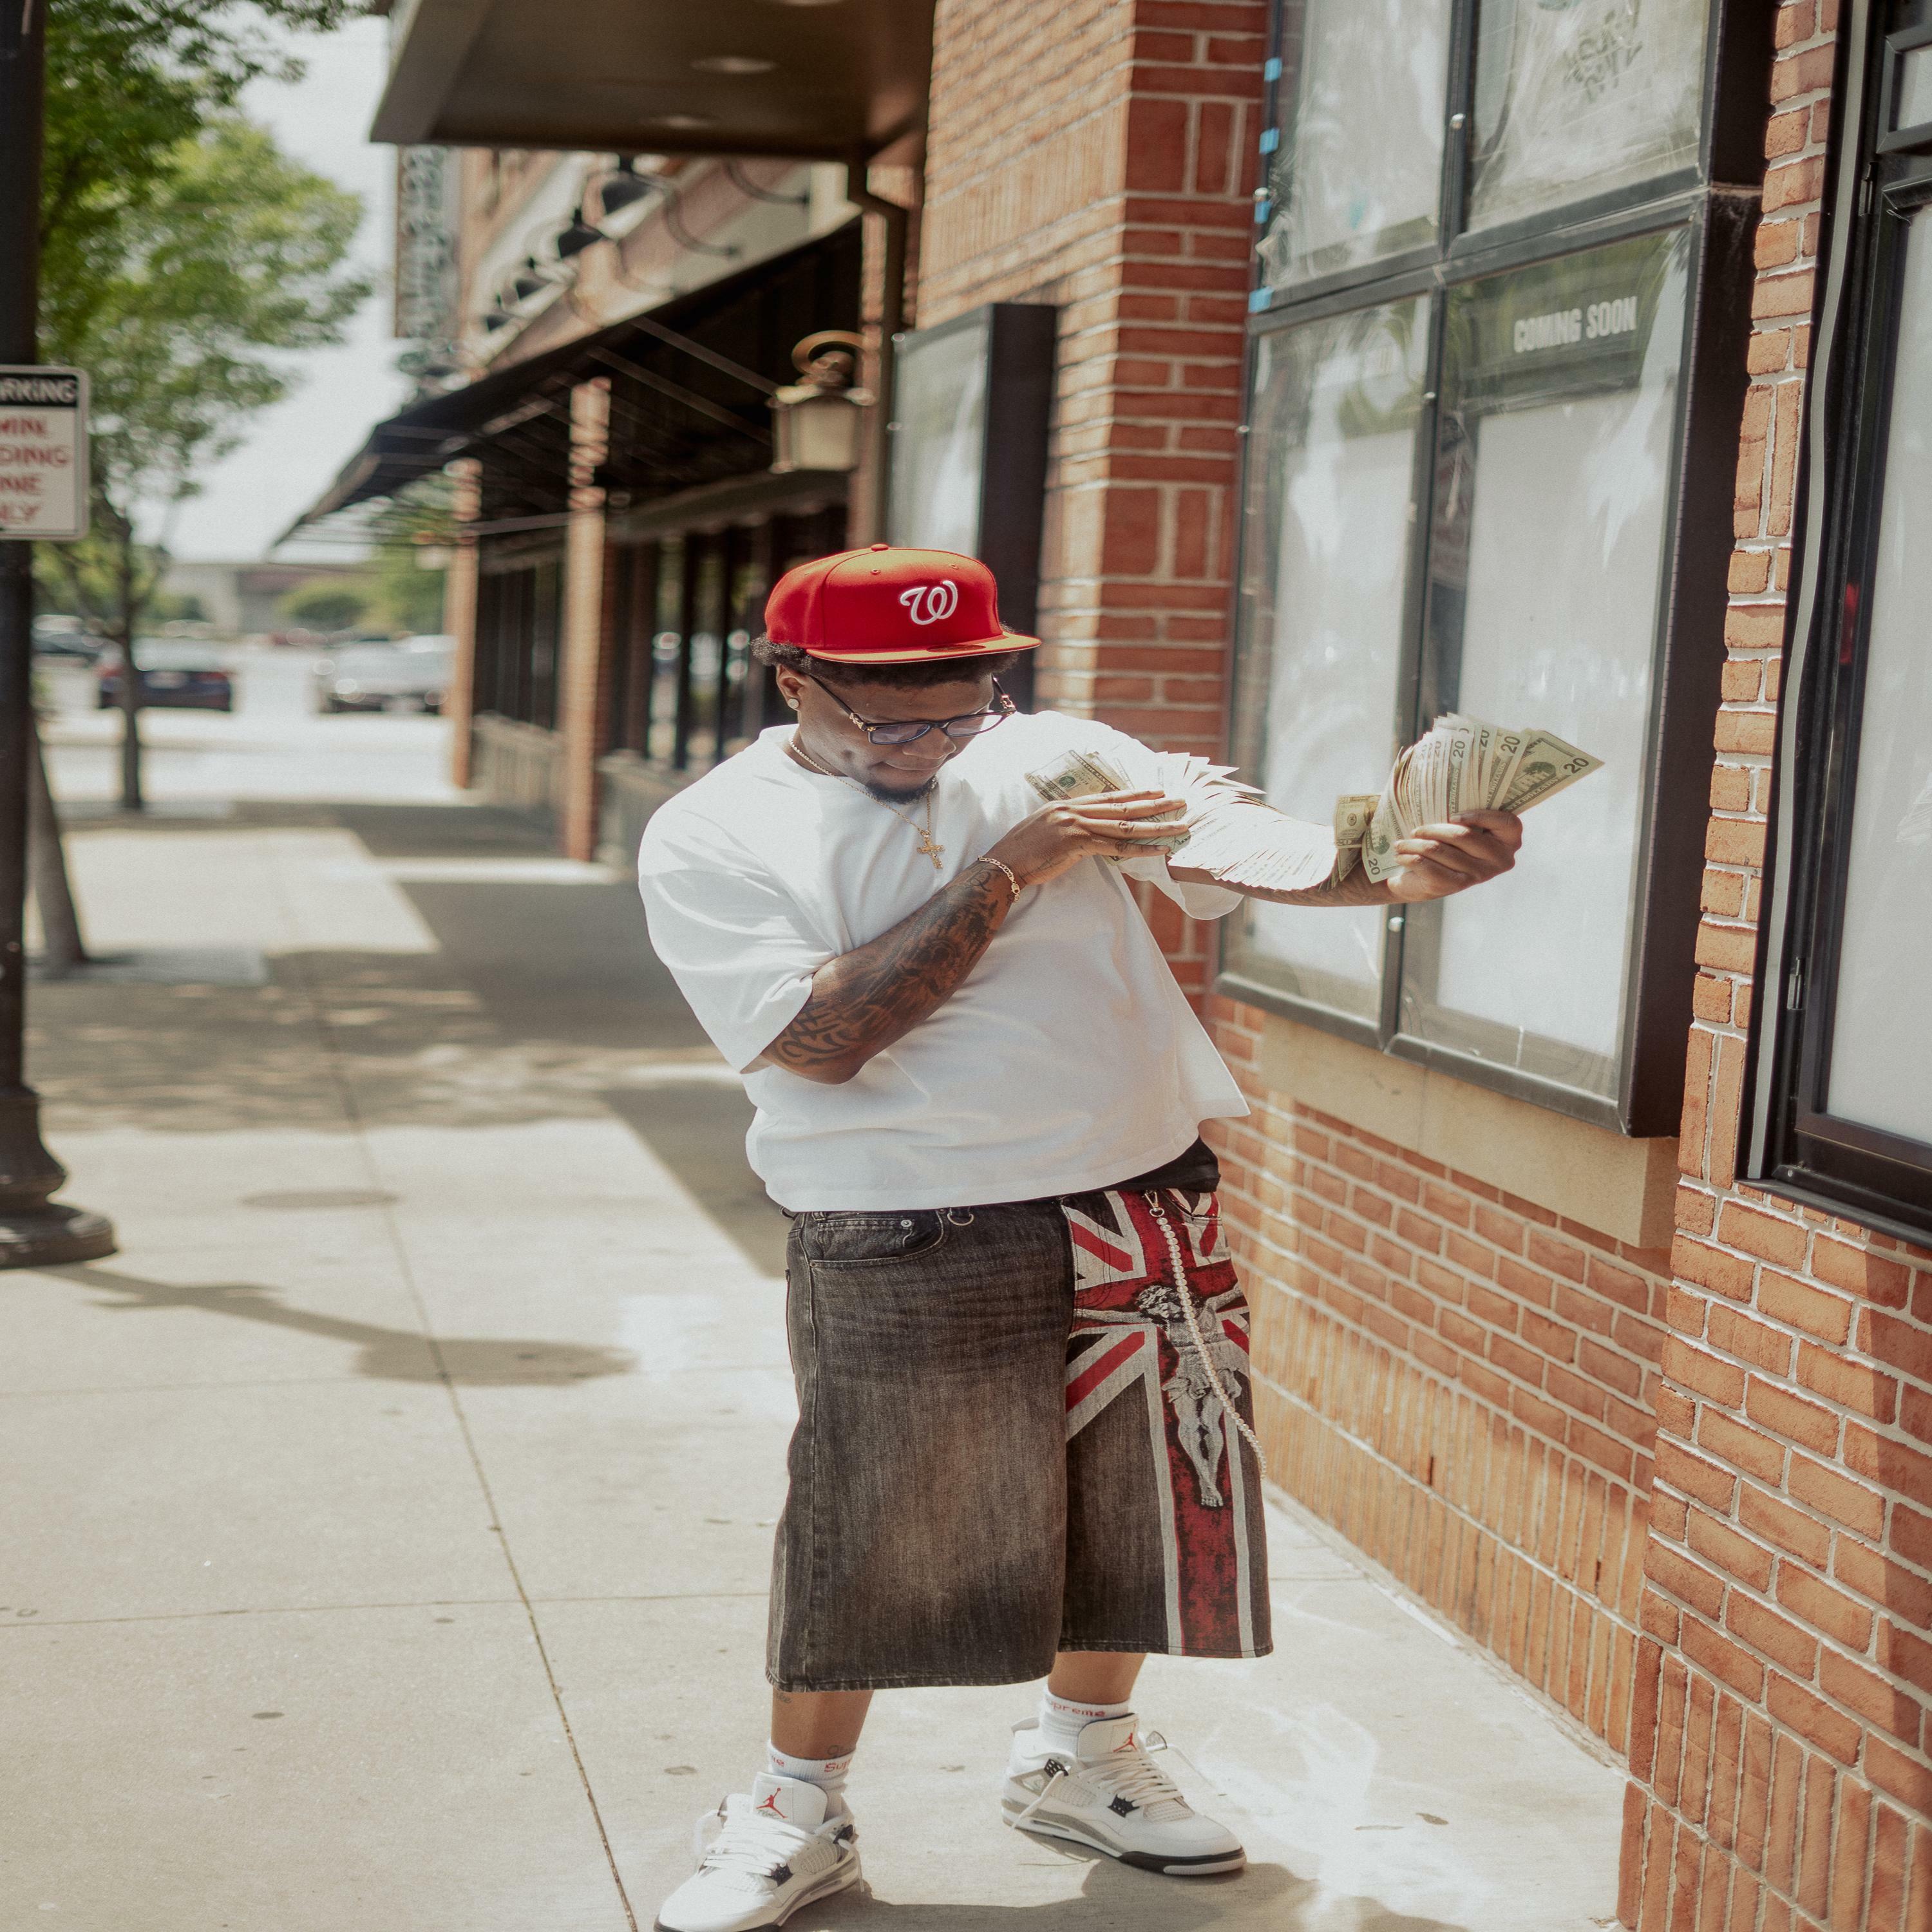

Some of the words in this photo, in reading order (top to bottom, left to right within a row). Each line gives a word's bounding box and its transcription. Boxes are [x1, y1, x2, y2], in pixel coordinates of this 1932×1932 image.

[1514, 308, 1582, 354] COMING
[1586, 296, 1638, 339] SOON
[0, 377, 76, 402] RKING
[0, 474, 41, 495] NE
[900, 580, 958, 625] W
[1453, 741, 1466, 759] 20
[1500, 735, 1520, 754] 20
[1563, 757, 1589, 774] 20
[1368, 858, 1381, 875] 20
[1050, 1701, 1106, 1718] preme
